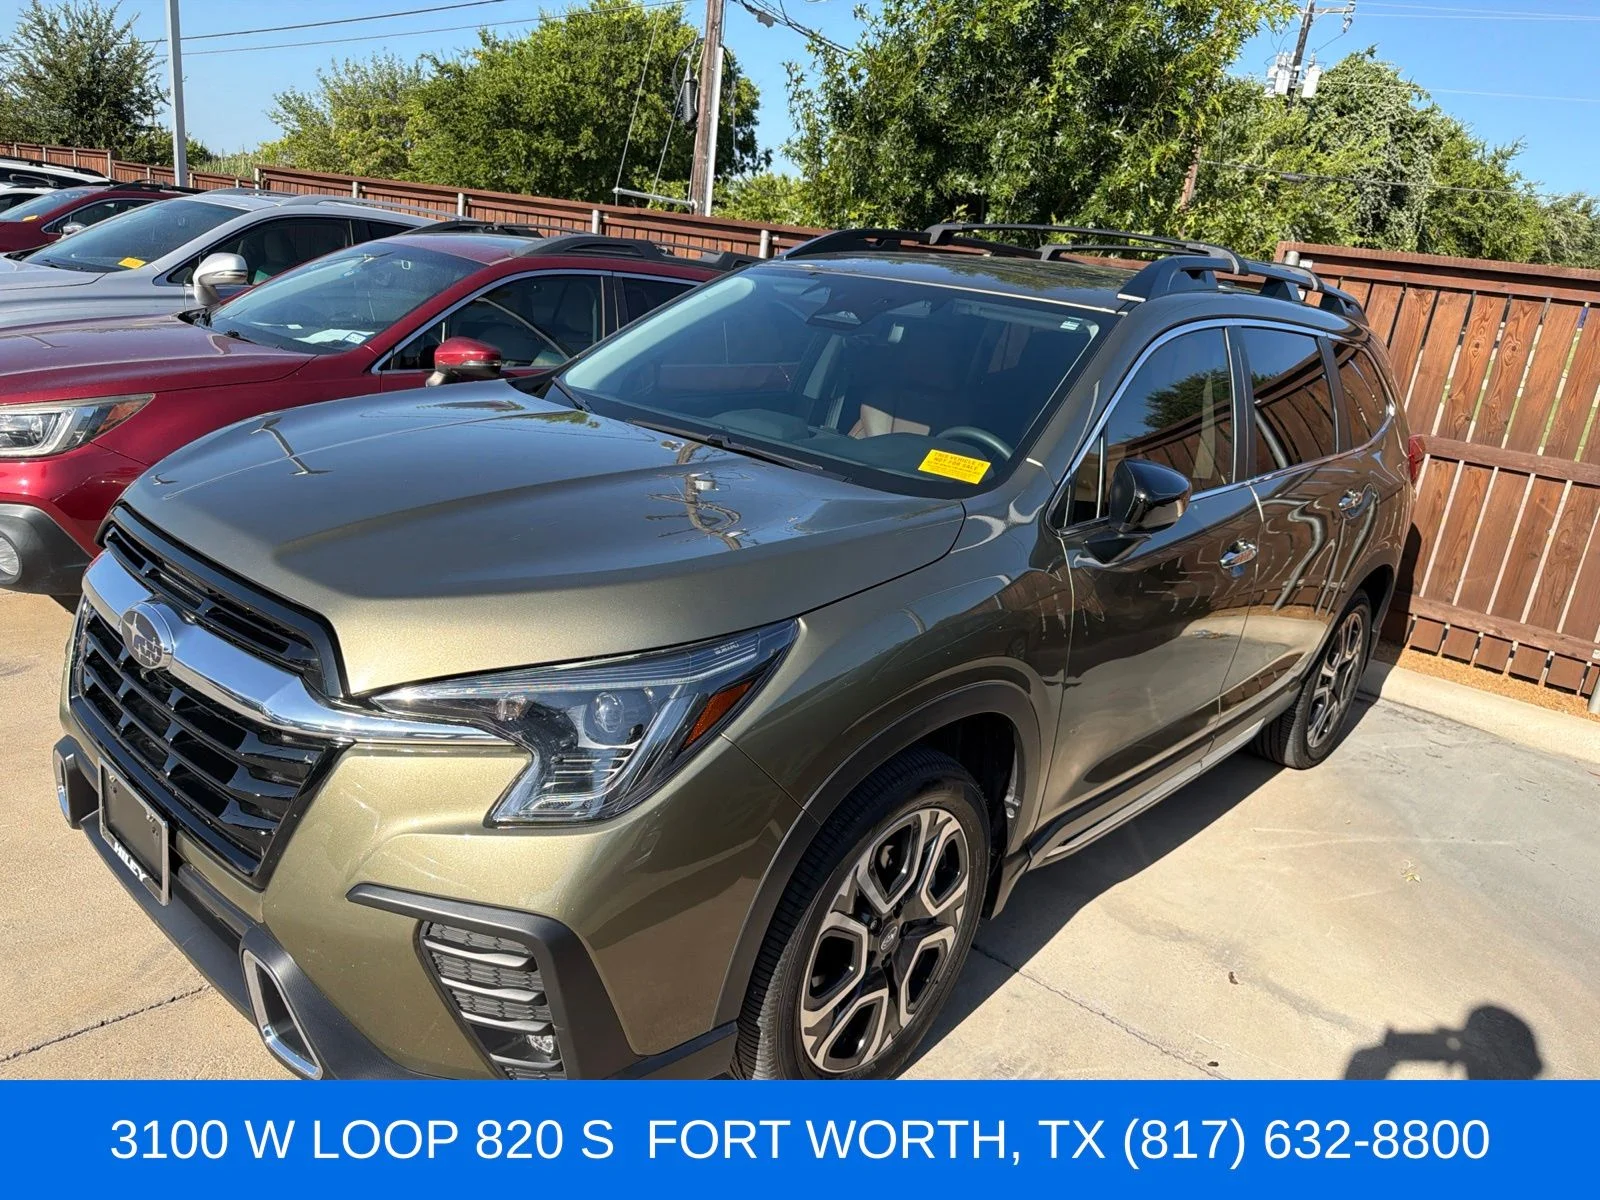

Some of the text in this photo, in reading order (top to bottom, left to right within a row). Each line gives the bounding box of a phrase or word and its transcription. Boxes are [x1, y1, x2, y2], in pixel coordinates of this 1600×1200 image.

[950, 455, 977, 465] VEHICLE
[962, 462, 979, 471] SALE
[113, 842, 148, 882] HILEY
